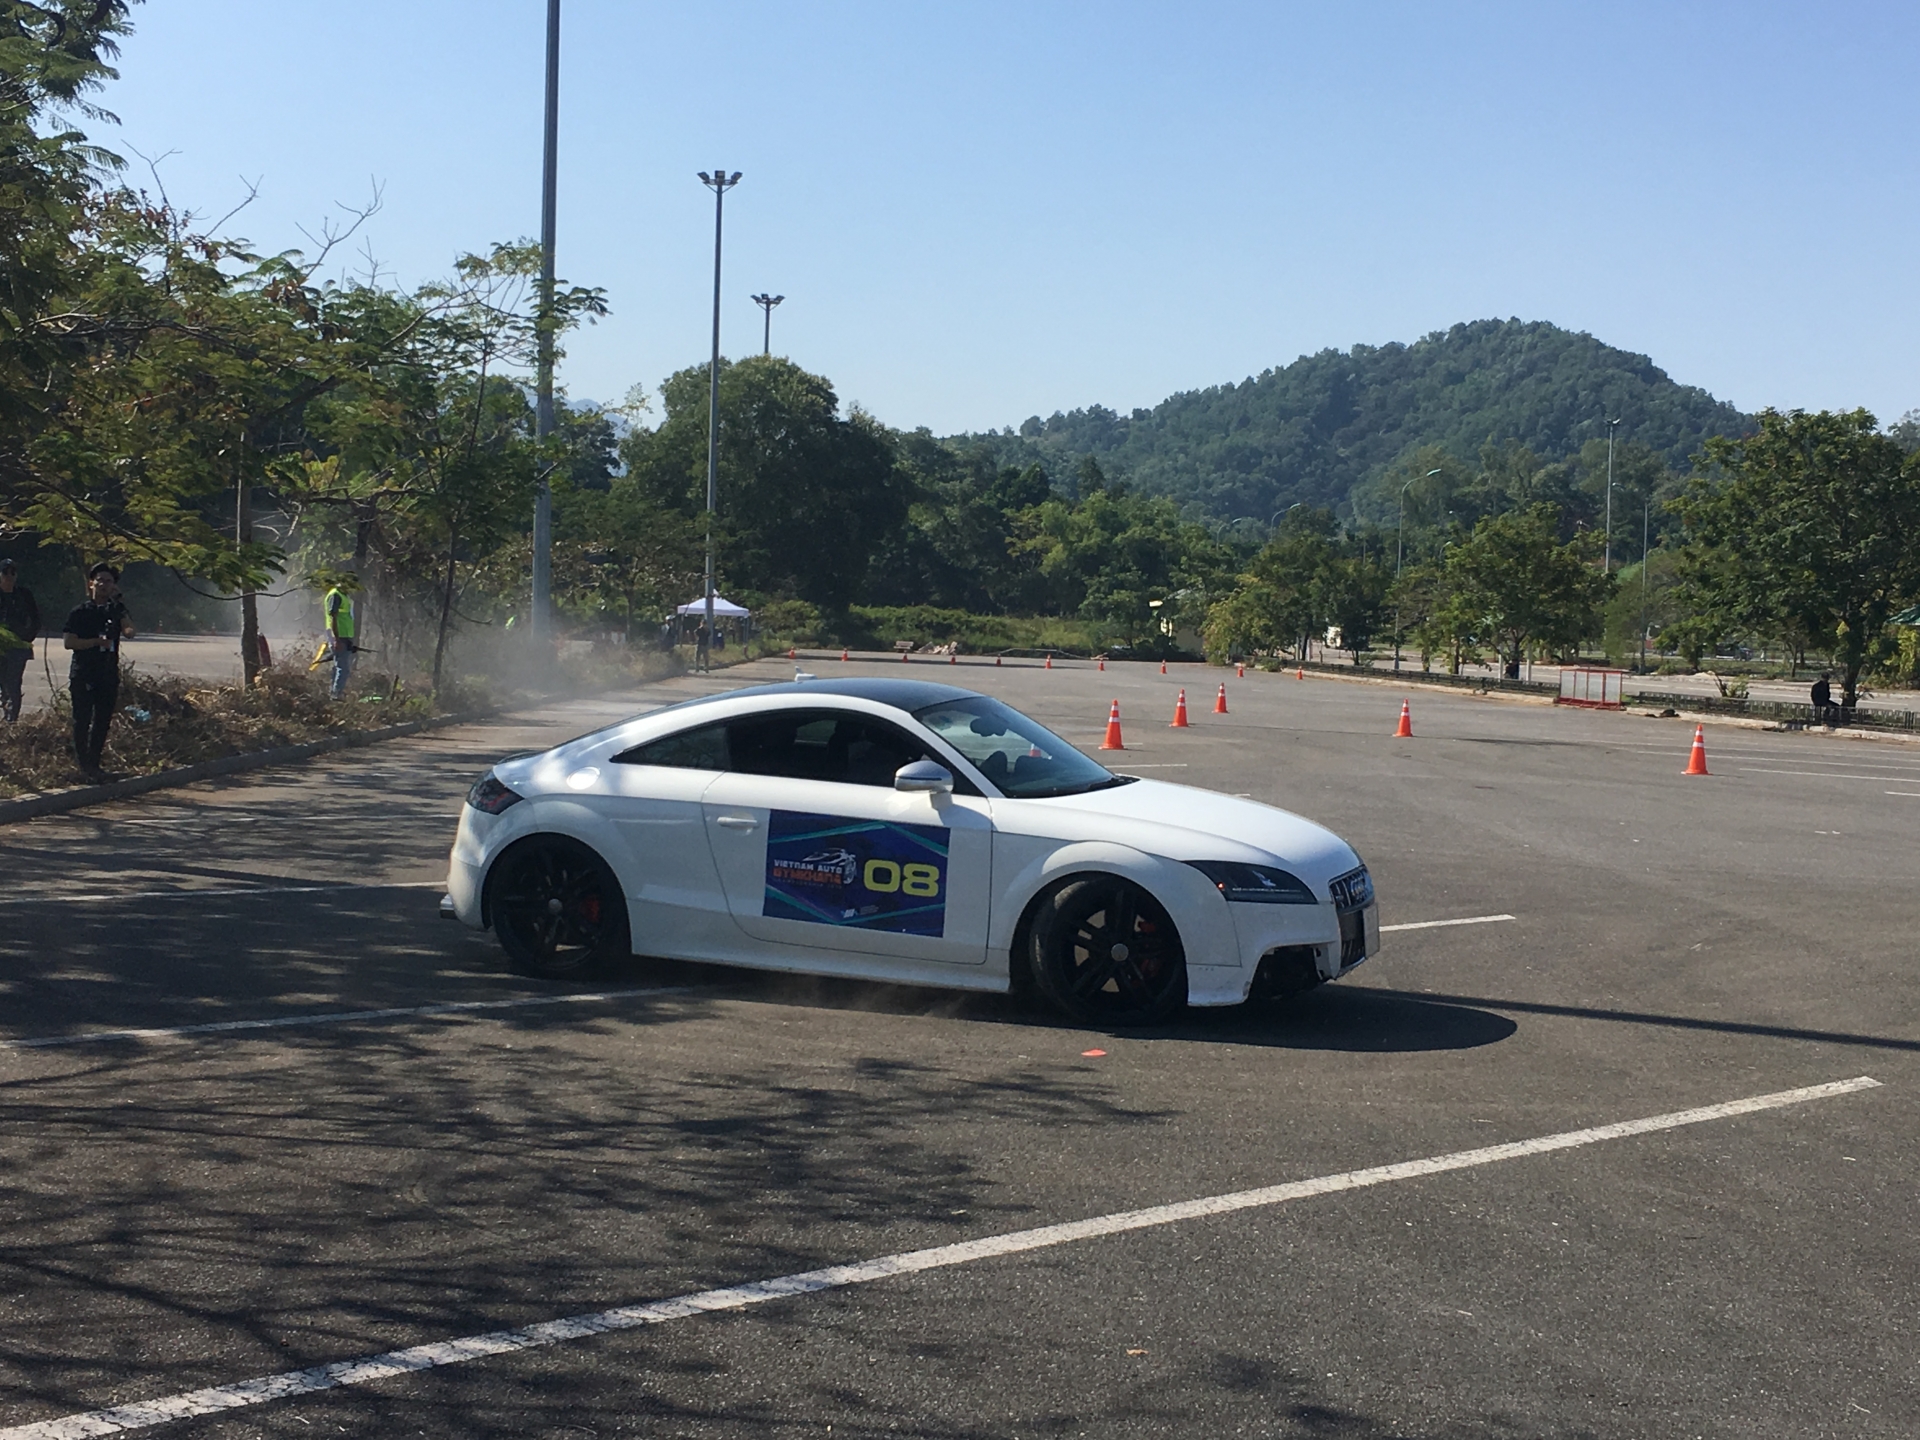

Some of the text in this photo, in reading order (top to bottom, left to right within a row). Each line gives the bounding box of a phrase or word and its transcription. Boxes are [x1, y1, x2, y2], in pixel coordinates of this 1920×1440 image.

[774, 859, 843, 874] VIETNAM AUTO
[863, 859, 940, 897] 08
